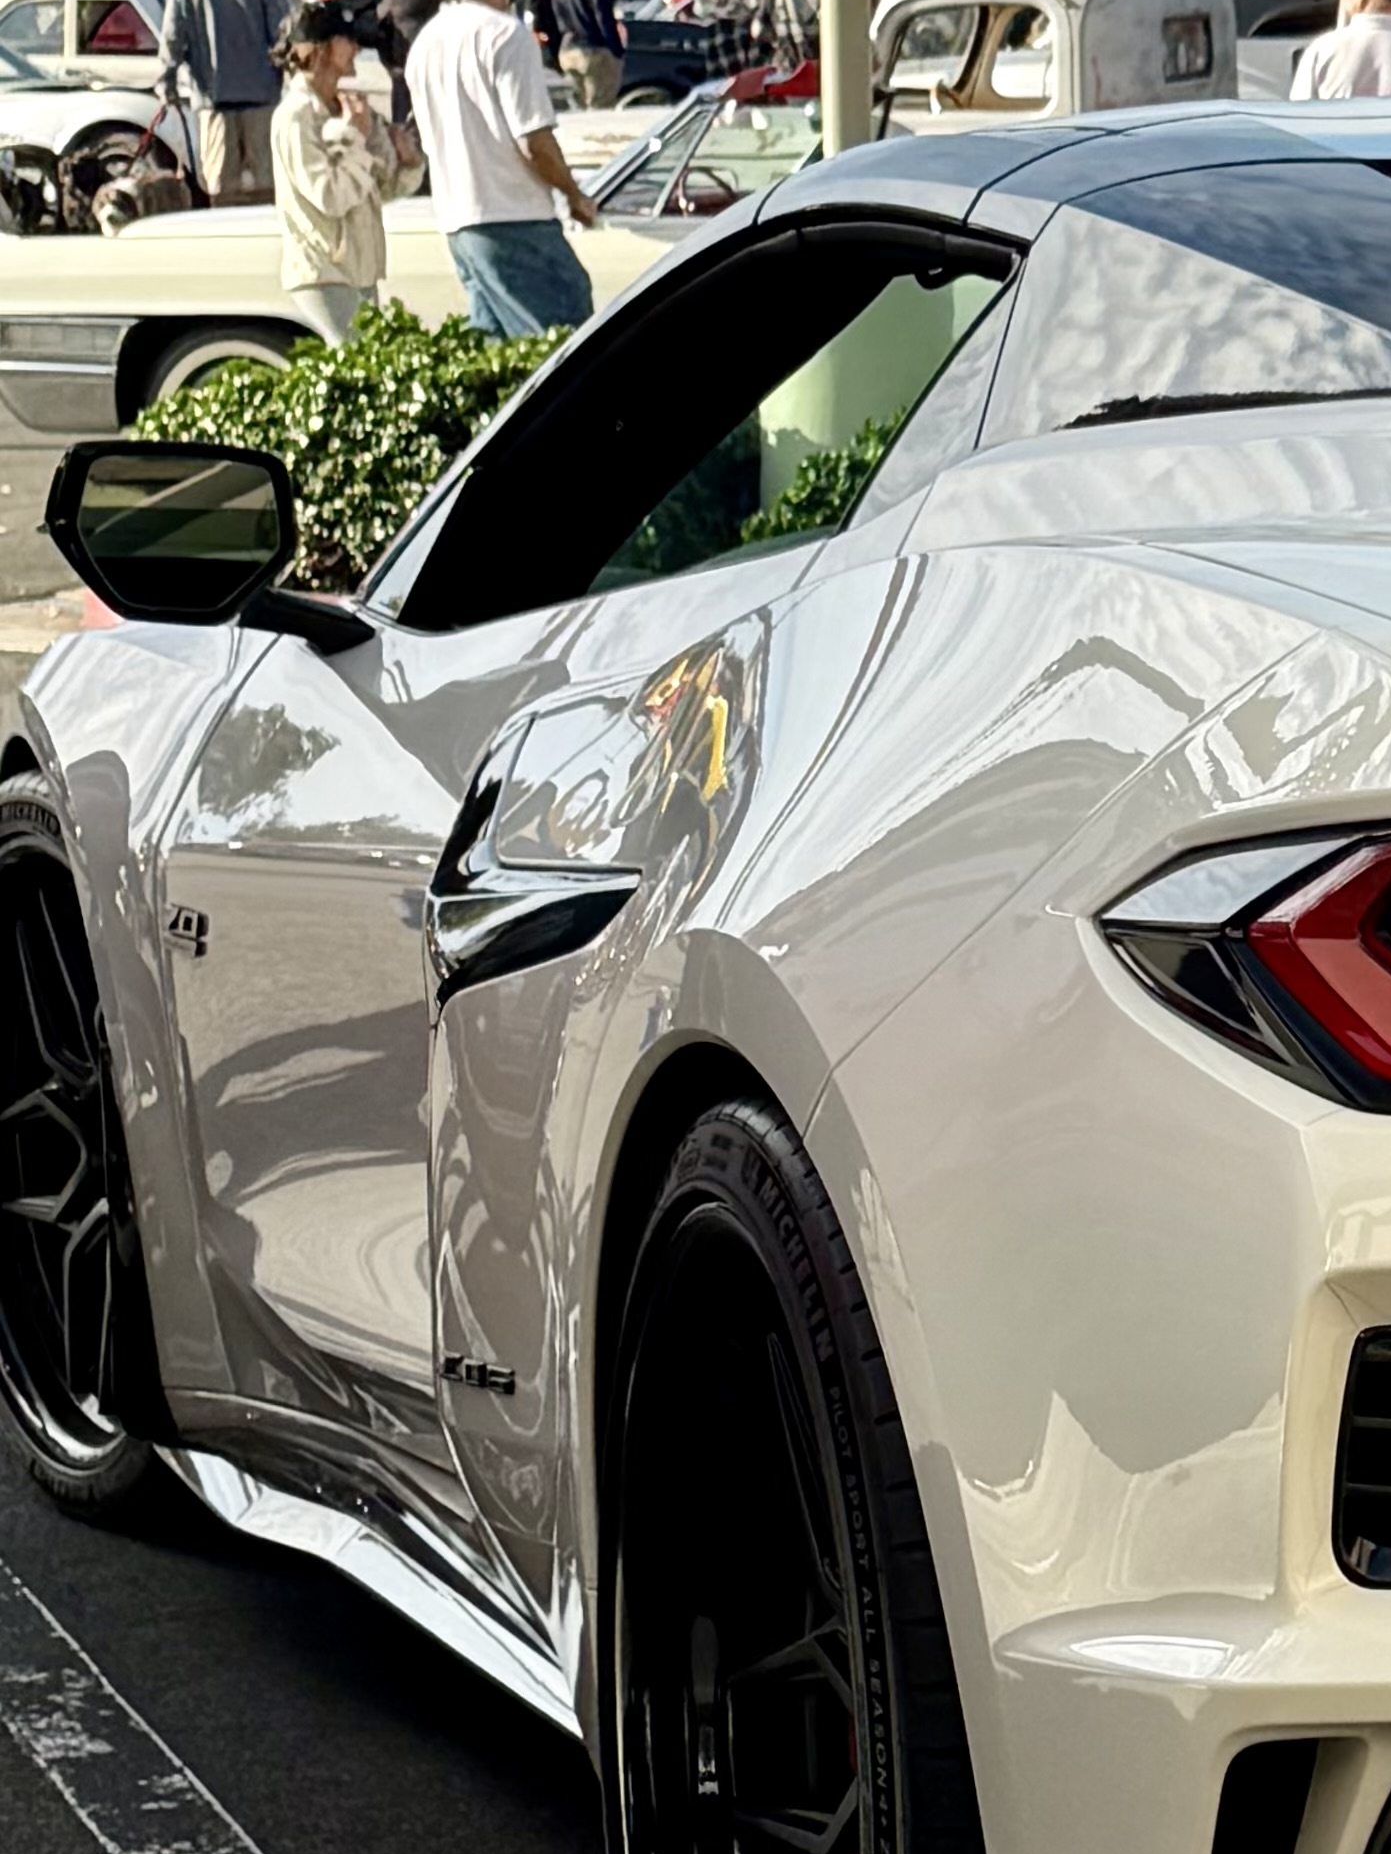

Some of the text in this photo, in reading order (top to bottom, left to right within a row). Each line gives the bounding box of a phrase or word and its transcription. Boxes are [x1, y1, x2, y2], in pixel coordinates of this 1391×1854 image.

[758, 1172, 836, 1363] MICHELIN
[827, 1385, 853, 1459] PILOT
[860, 1585, 877, 1644] ALL
